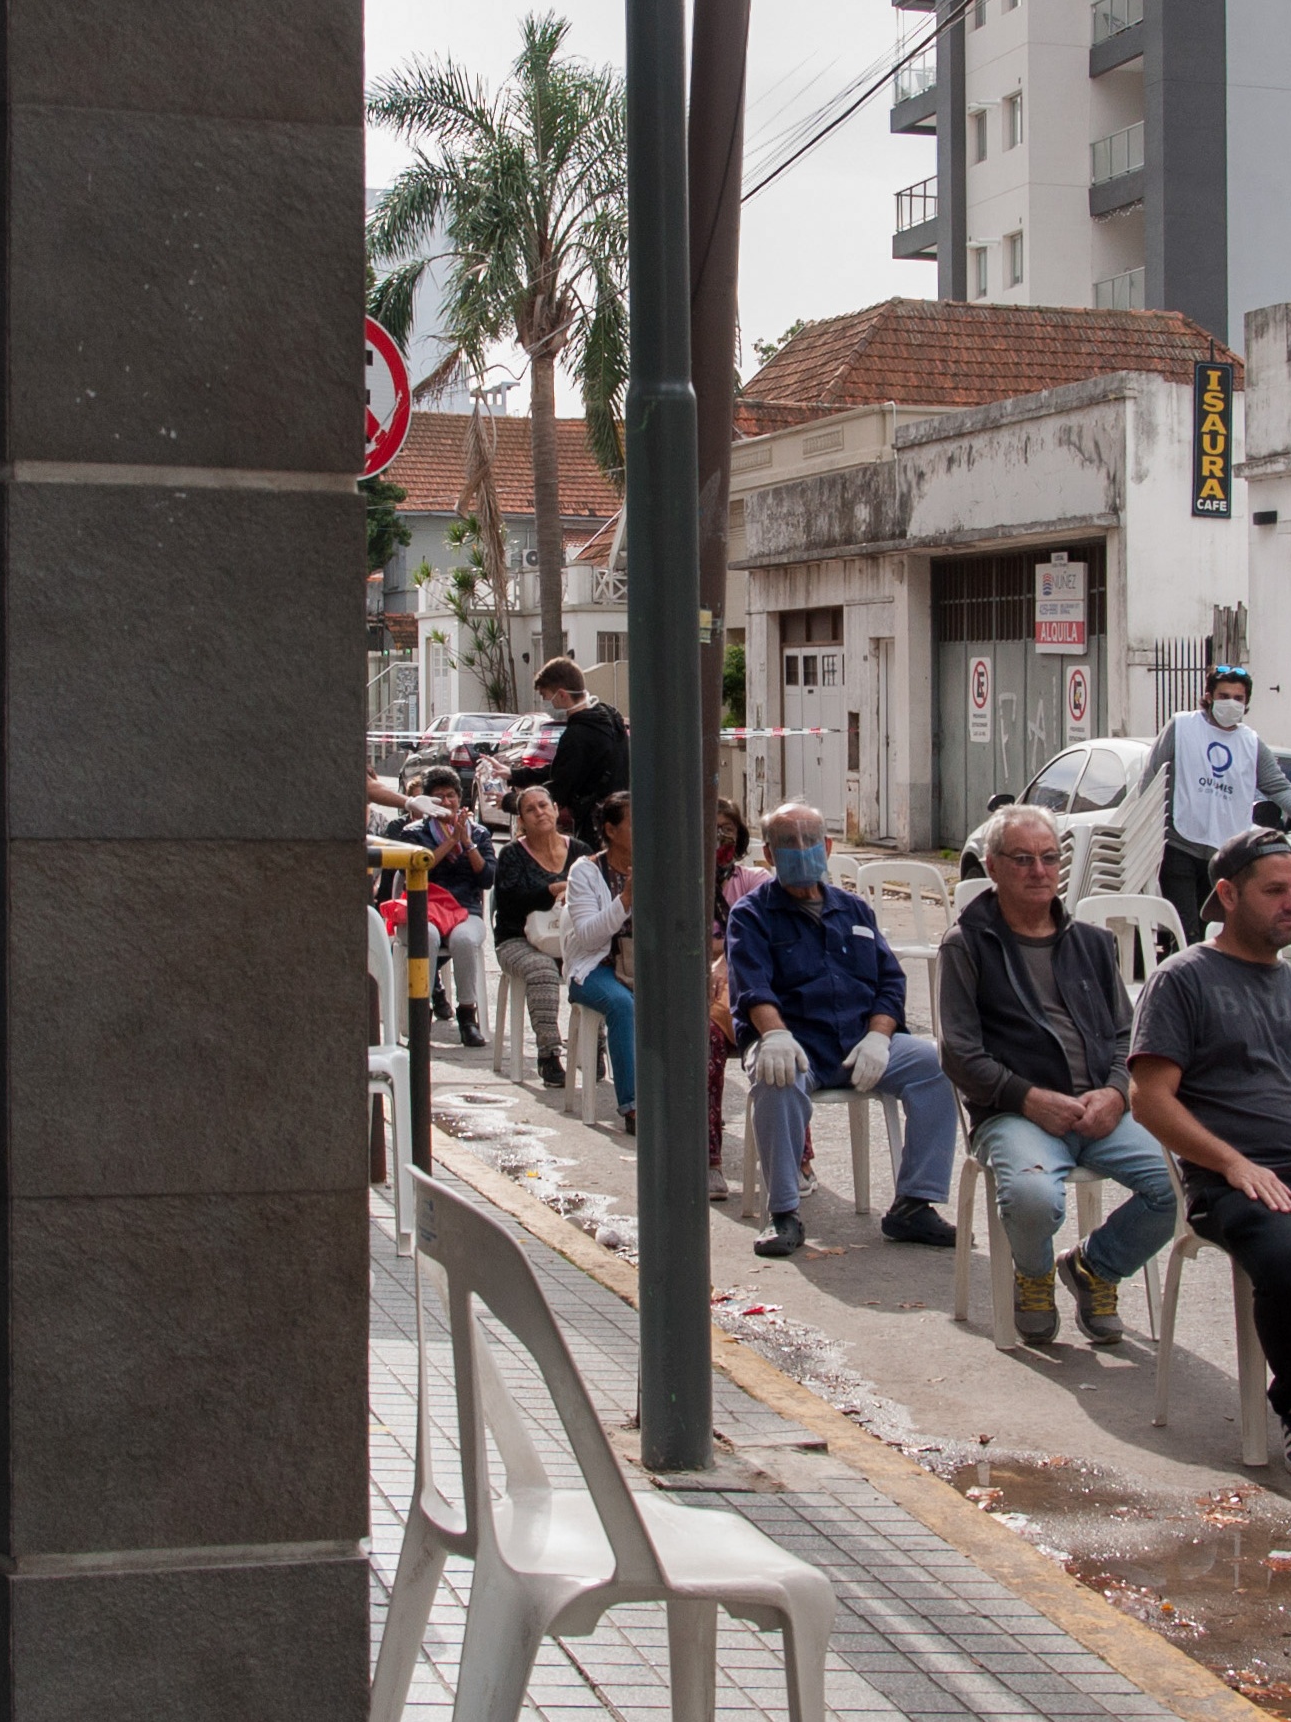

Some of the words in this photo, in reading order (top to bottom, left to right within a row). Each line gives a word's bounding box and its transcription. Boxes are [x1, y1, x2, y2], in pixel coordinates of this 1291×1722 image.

[1200, 370, 1227, 499] ISAURA
[1197, 498, 1227, 512] CAFE
[1040, 622, 1078, 642] ALQUILA
